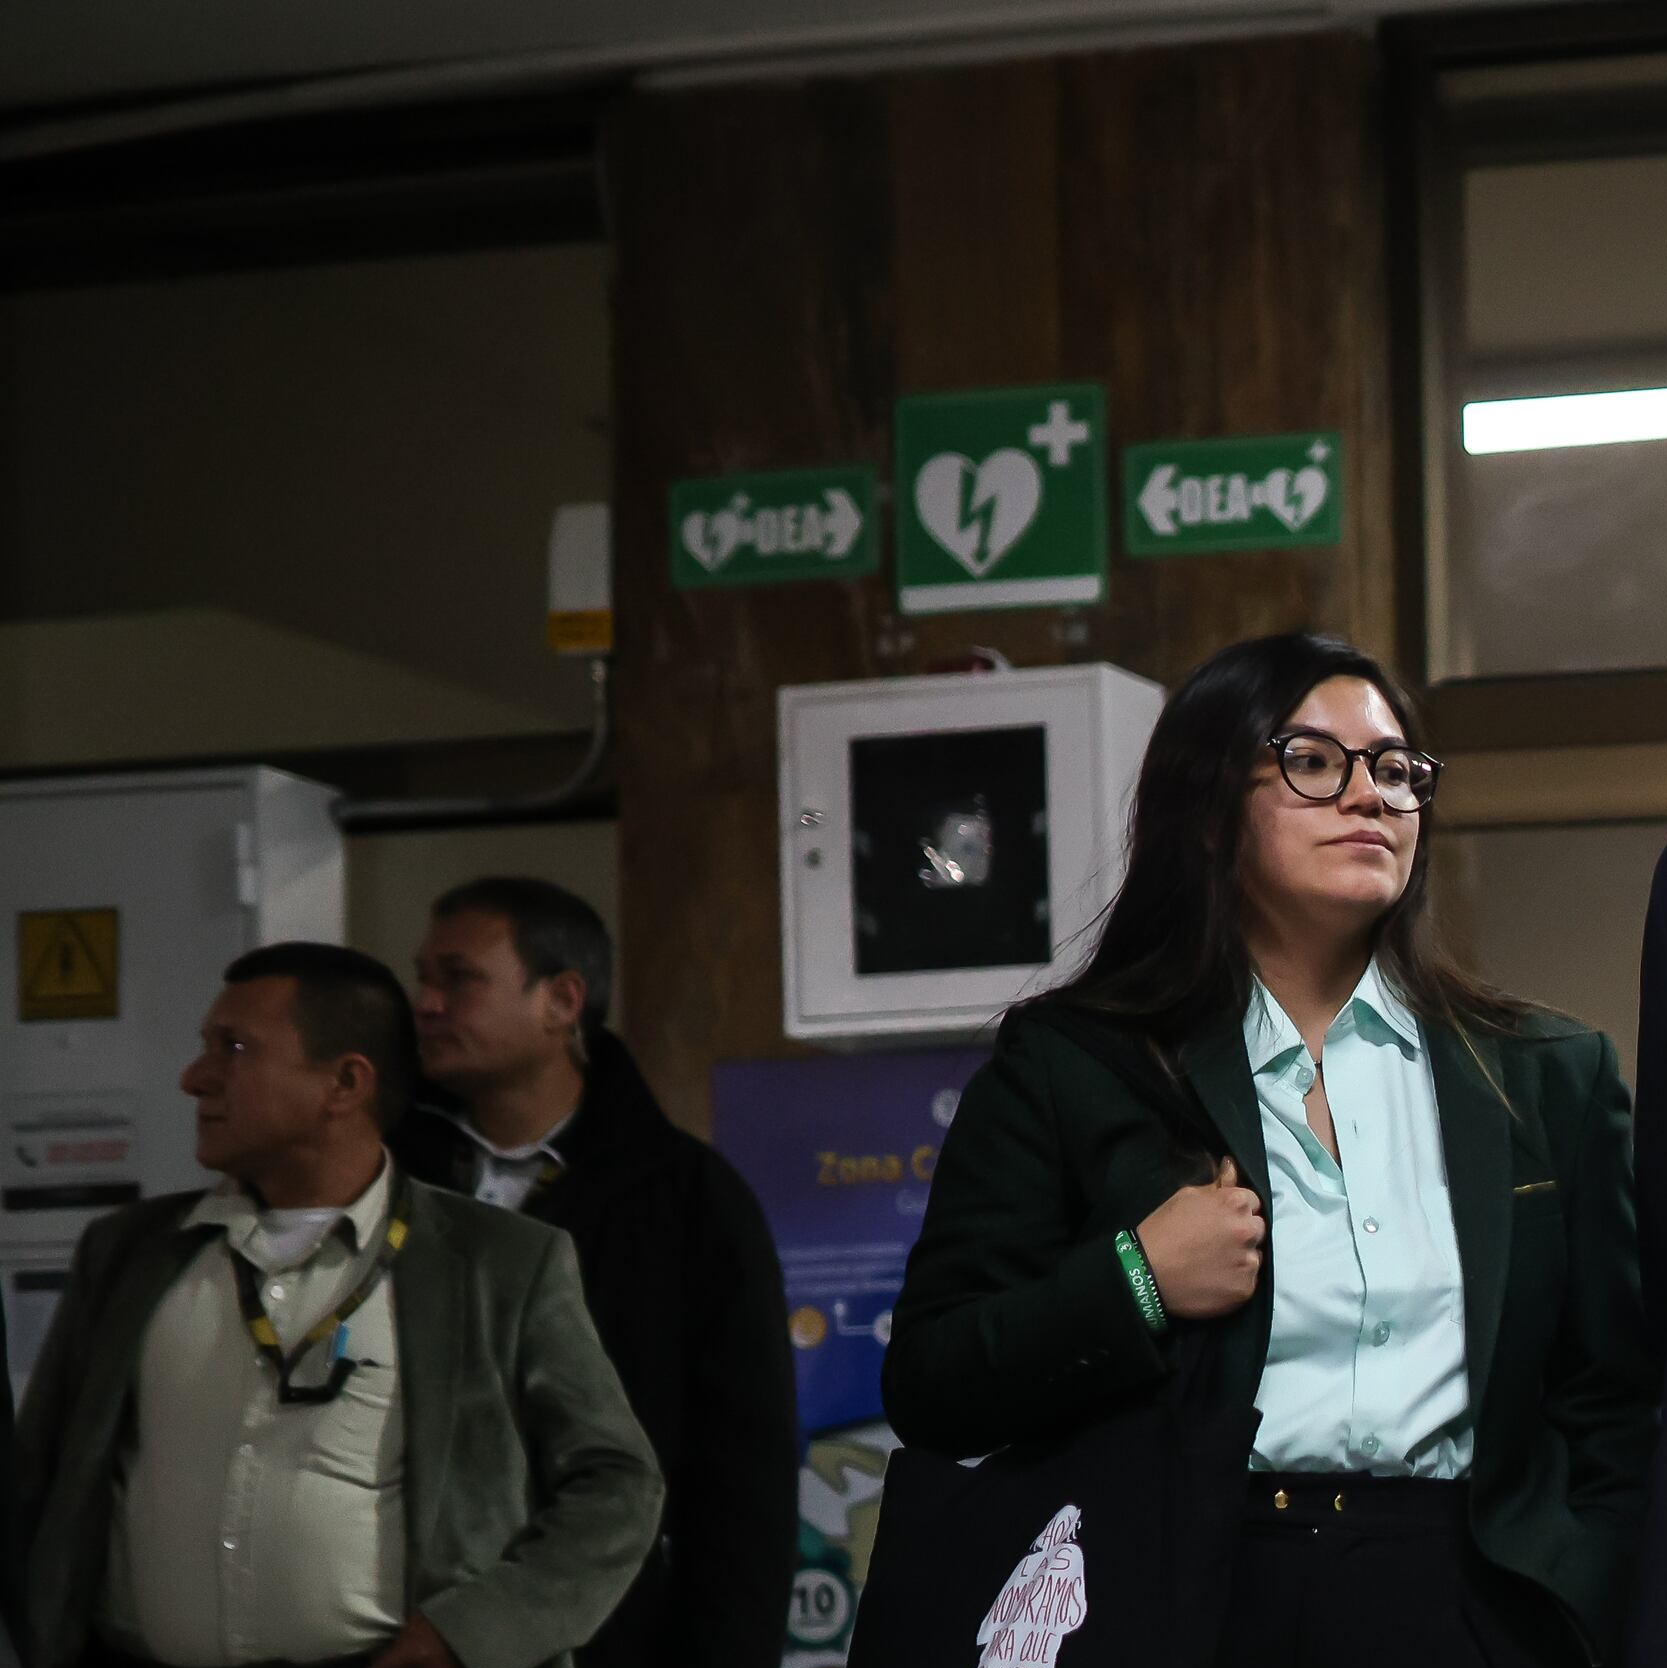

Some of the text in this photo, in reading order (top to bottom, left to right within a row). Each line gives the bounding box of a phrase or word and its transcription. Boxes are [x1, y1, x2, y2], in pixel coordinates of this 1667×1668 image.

[1181, 475, 1251, 524] DEA
[756, 506, 823, 553] DEA
[817, 1151, 901, 1185] Zona
[1129, 1268, 1158, 1325] UMANOS
[1020, 1548, 1072, 1577] LAS
[793, 1583, 835, 1615] 10
[1020, 1628, 1056, 1663] QUE
